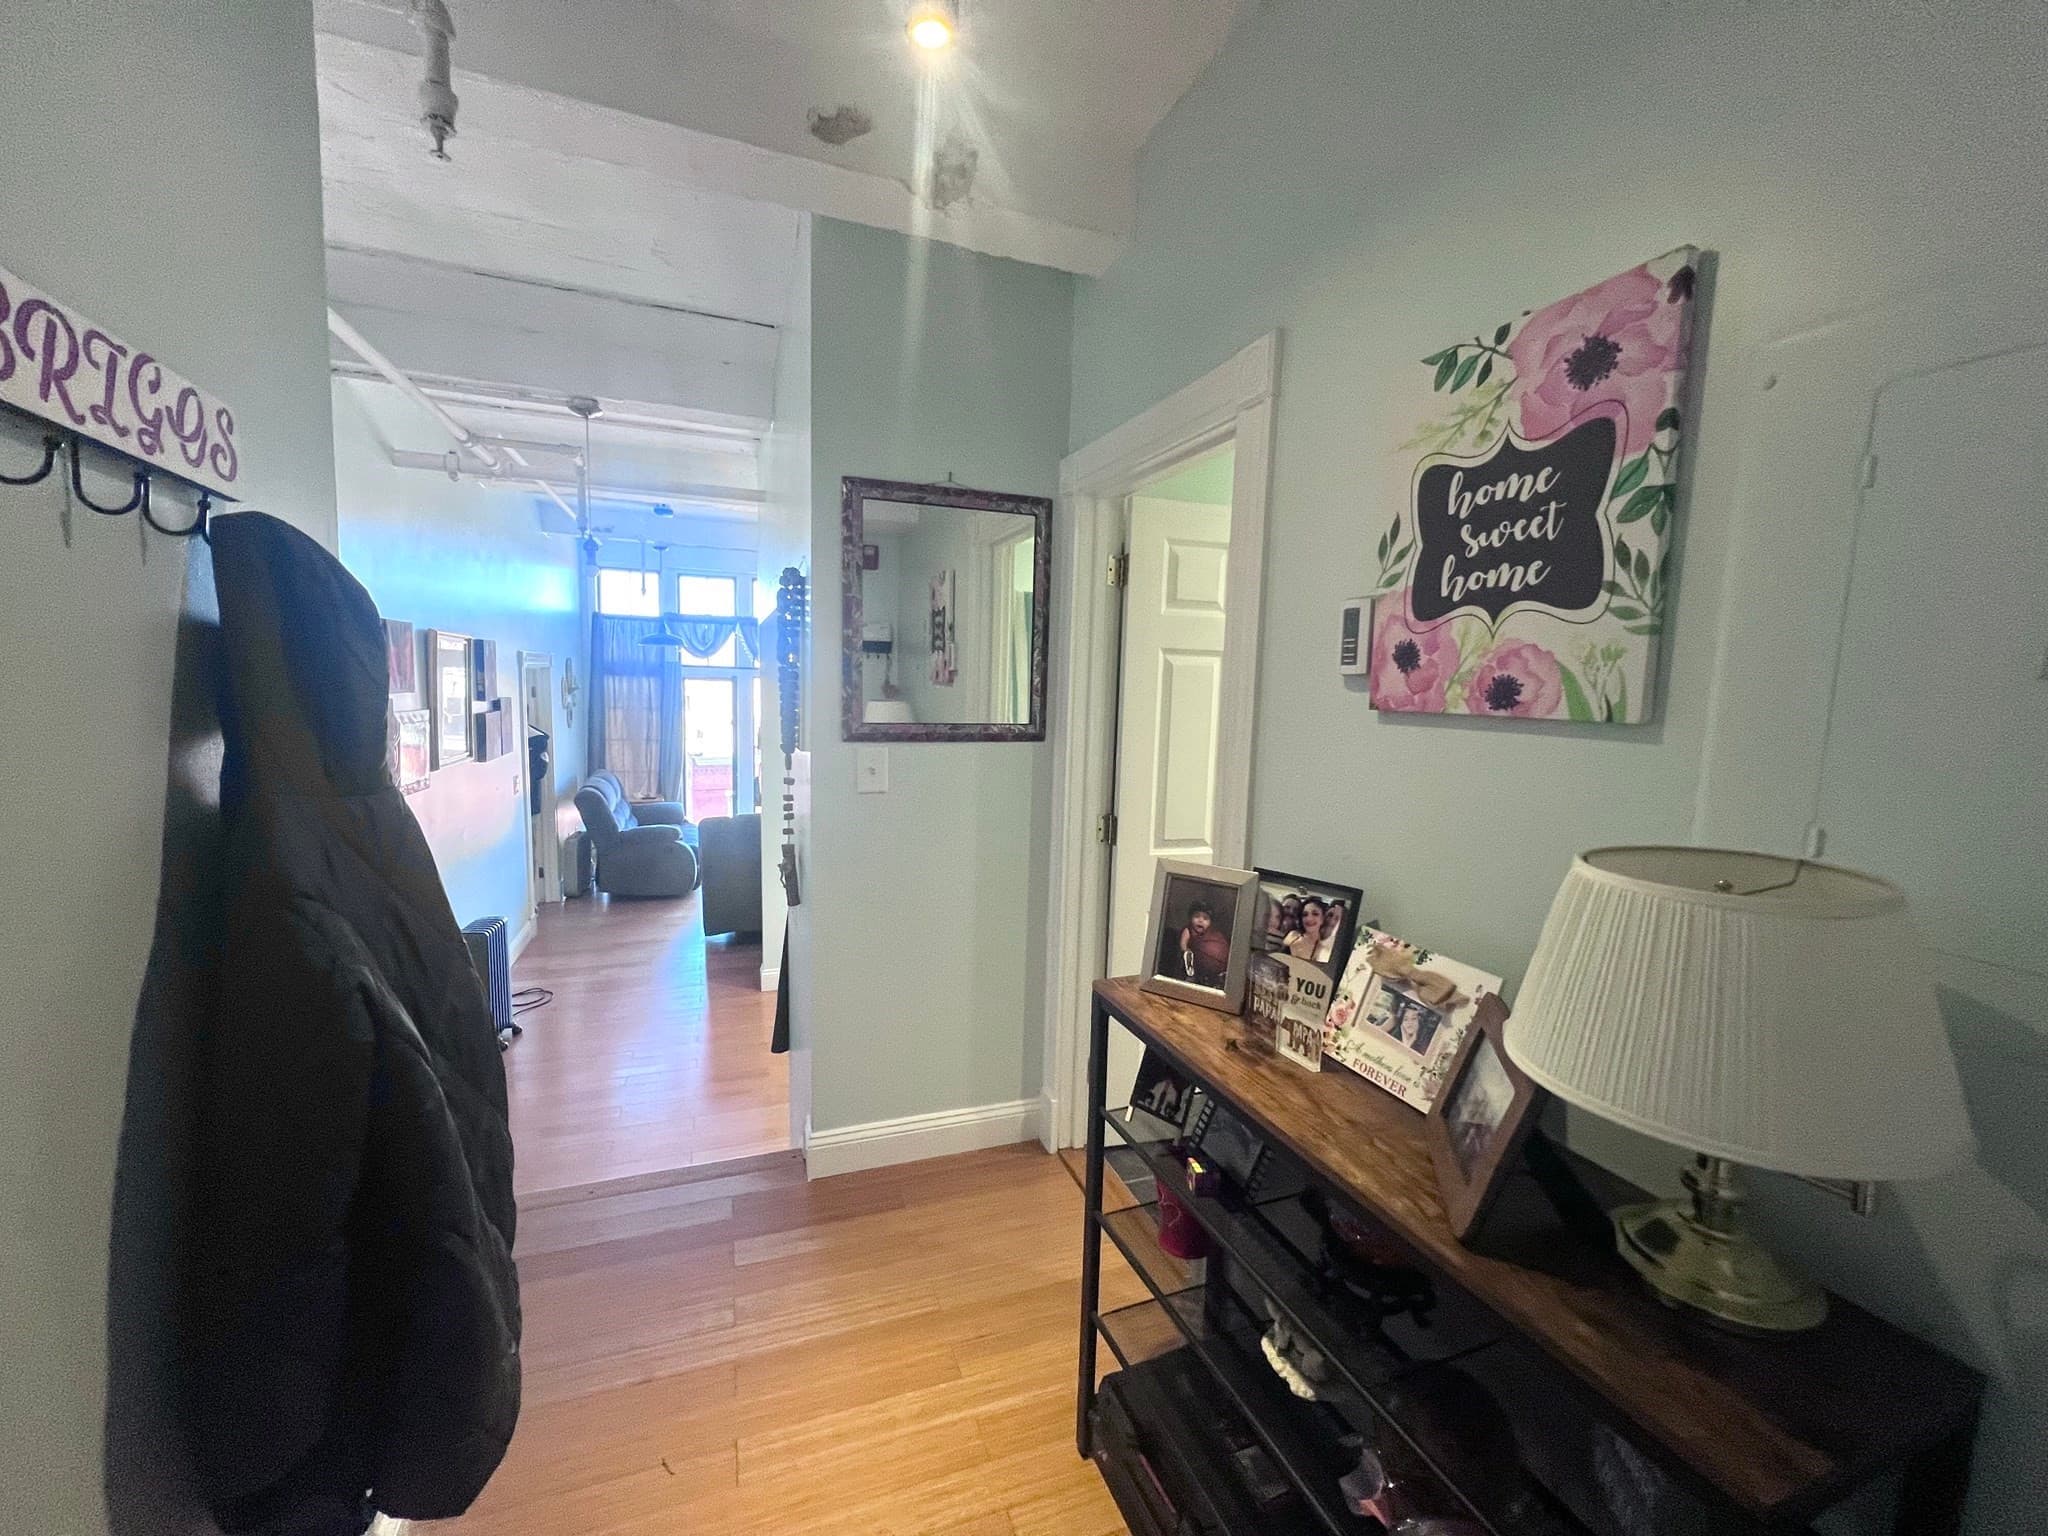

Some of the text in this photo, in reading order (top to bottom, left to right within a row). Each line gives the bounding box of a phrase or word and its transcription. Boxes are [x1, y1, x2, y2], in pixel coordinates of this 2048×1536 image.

[1448, 466, 1561, 519] home
[1460, 500, 1567, 558] sweet
[1440, 554, 1551, 602] home
[1296, 977, 1326, 999] YOU
[1352, 1058, 1407, 1098] FOREVER
